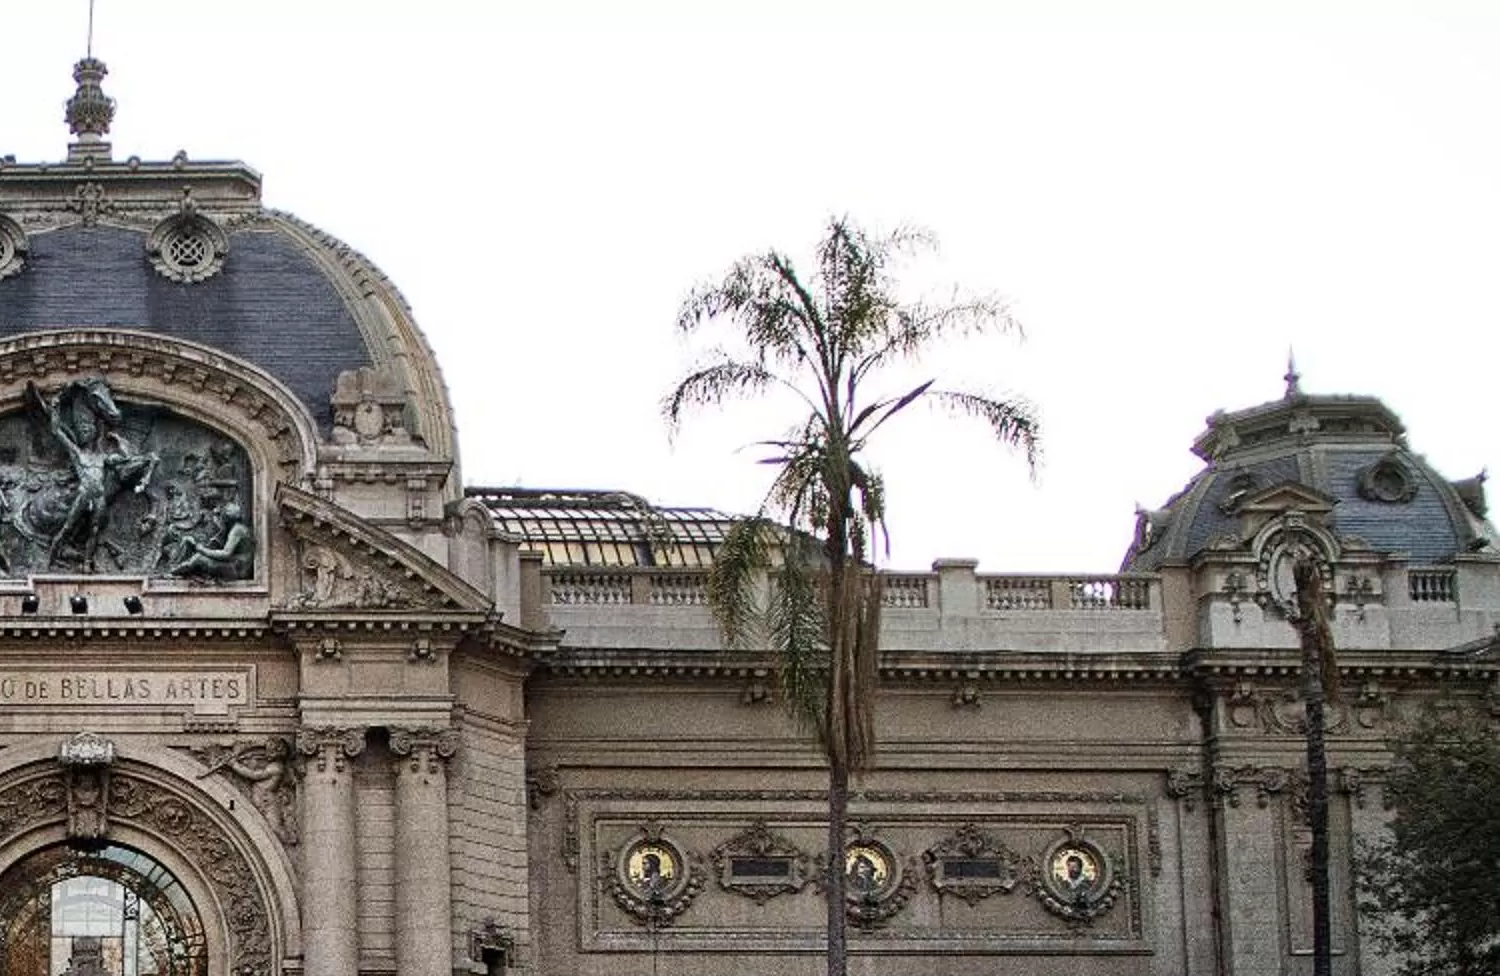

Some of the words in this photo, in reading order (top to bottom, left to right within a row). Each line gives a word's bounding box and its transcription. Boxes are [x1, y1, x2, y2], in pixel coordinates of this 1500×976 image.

[25, 680, 49, 699] DE
[60, 678, 151, 700] BELLAS
[165, 679, 241, 700] ARTES
